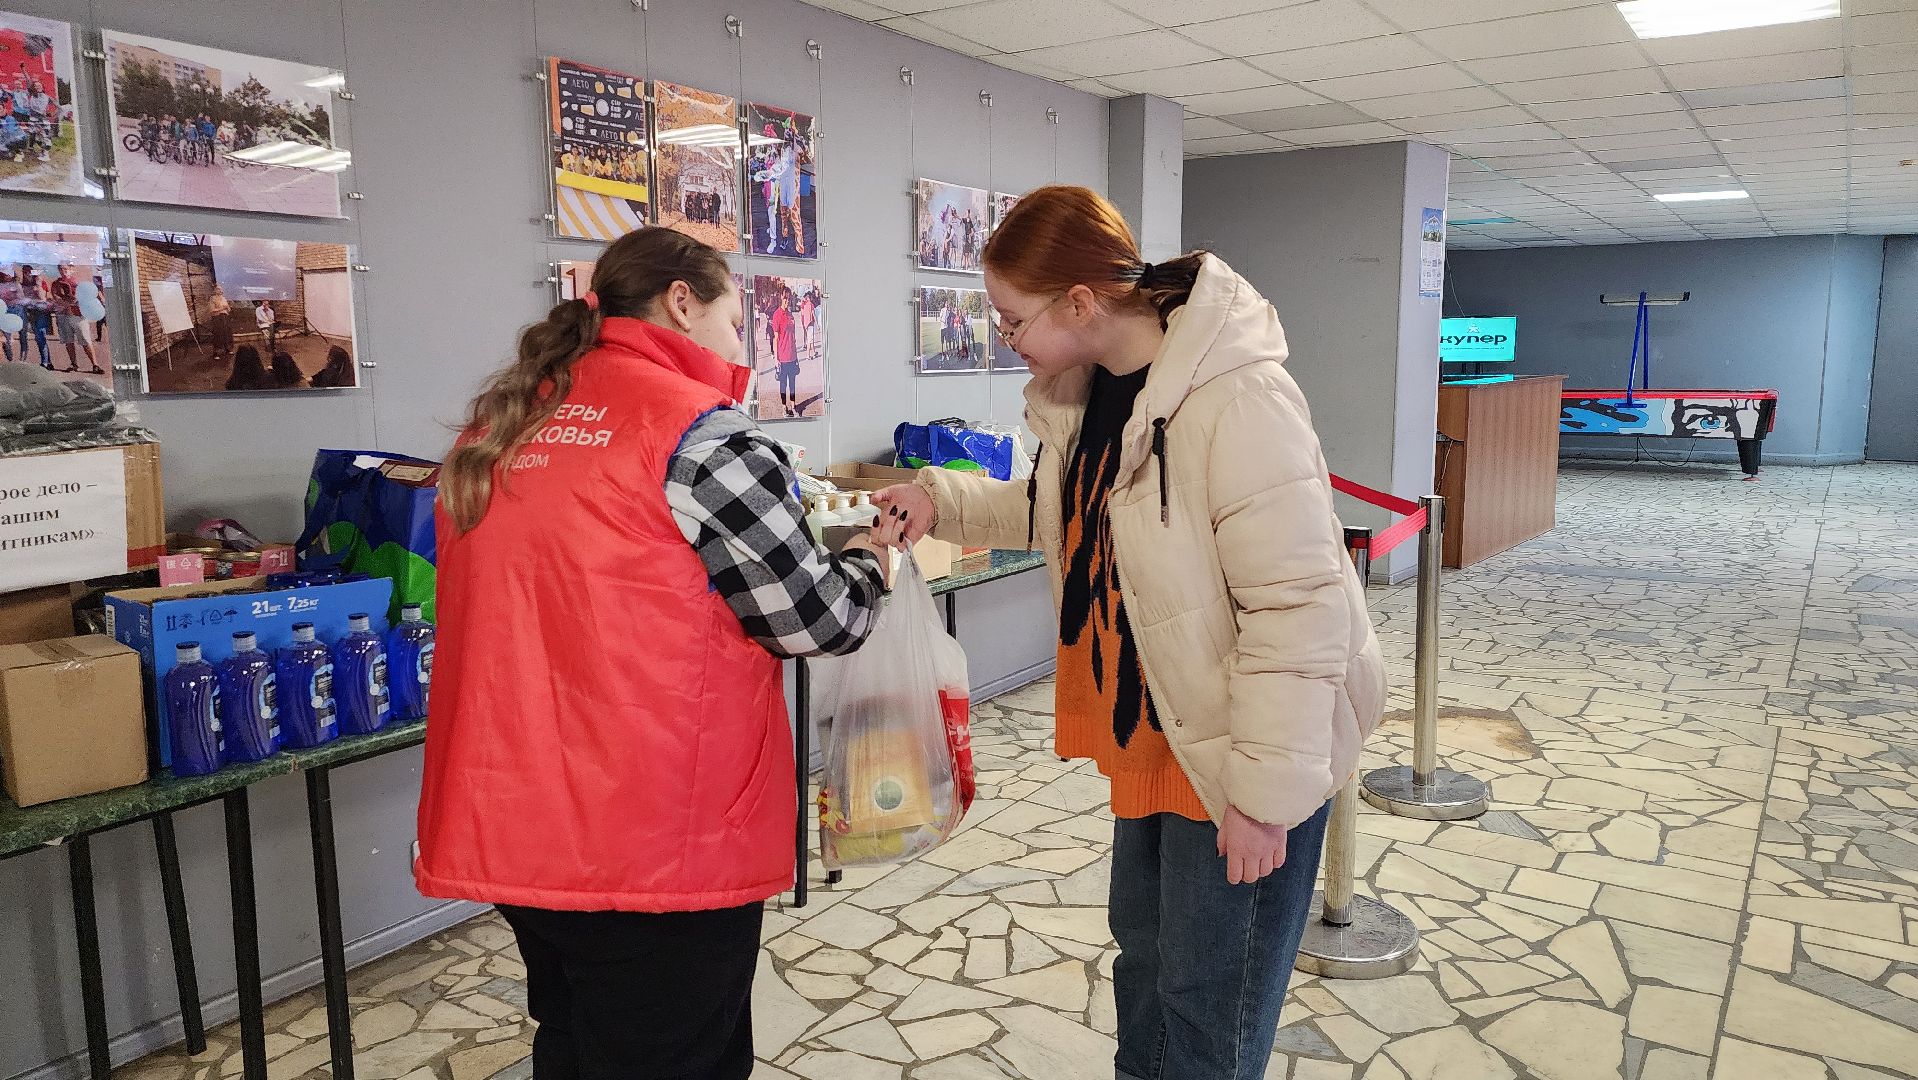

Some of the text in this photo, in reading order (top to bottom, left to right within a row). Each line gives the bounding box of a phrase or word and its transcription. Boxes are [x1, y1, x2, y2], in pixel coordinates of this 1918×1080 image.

[600, 129, 618, 141] ЛЕТО
[1440, 334, 1508, 345] купер
[504, 454, 550, 470] ДОМ
[36, 482, 81, 498] дело
[1, 509, 60, 525] ашим
